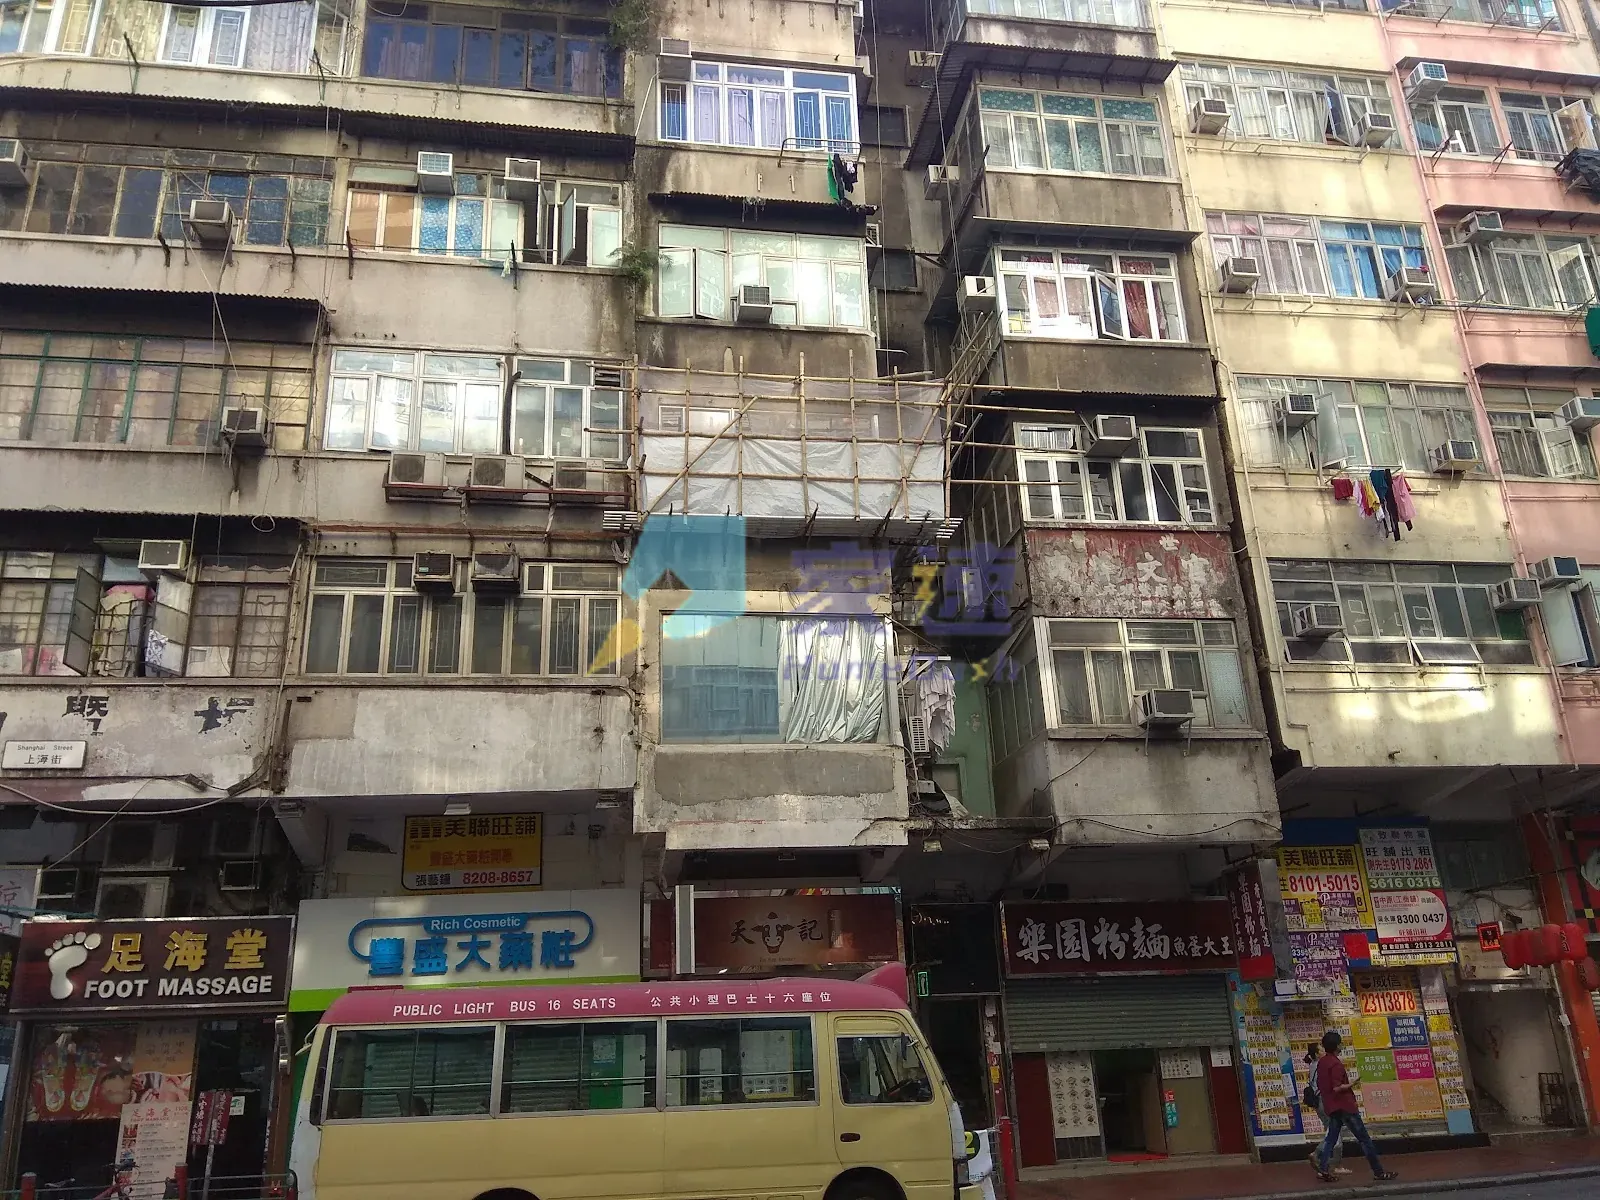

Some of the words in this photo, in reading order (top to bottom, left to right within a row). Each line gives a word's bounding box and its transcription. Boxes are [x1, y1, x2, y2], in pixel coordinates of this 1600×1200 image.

[17, 744, 46, 752] Shanghai
[23, 754, 62, 766] 上海街
[1390, 858, 1412, 871] 9179
[1412, 857, 1434, 870] 2861
[462, 871, 534, 885] 8208-8657
[1288, 875, 1360, 893] 8101-5015
[1369, 877, 1404, 889] 3616
[1407, 876, 1441, 888] 0316
[431, 918, 460, 931] Rich
[463, 915, 521, 930] Cosmetic
[1396, 914, 1420, 924] 8300
[1422, 913, 1444, 923] 0437
[101, 928, 268, 974] 足海堂
[1171, 934, 1234, 958] 魚蛋大王
[84, 979, 149, 999] FOOT
[157, 975, 273, 997] MASSAGE
[1372, 973, 1402, 988] 威信
[393, 1004, 442, 1017] PUBLIC
[454, 1002, 494, 1015] LIGHT
[510, 1000, 536, 1013] BUS
[547, 999, 561, 1011] 16
[572, 997, 616, 1010] SEATS
[650, 991, 832, 1007] 公共小型巴士十六座位
[1361, 991, 1415, 1013] 23113878
